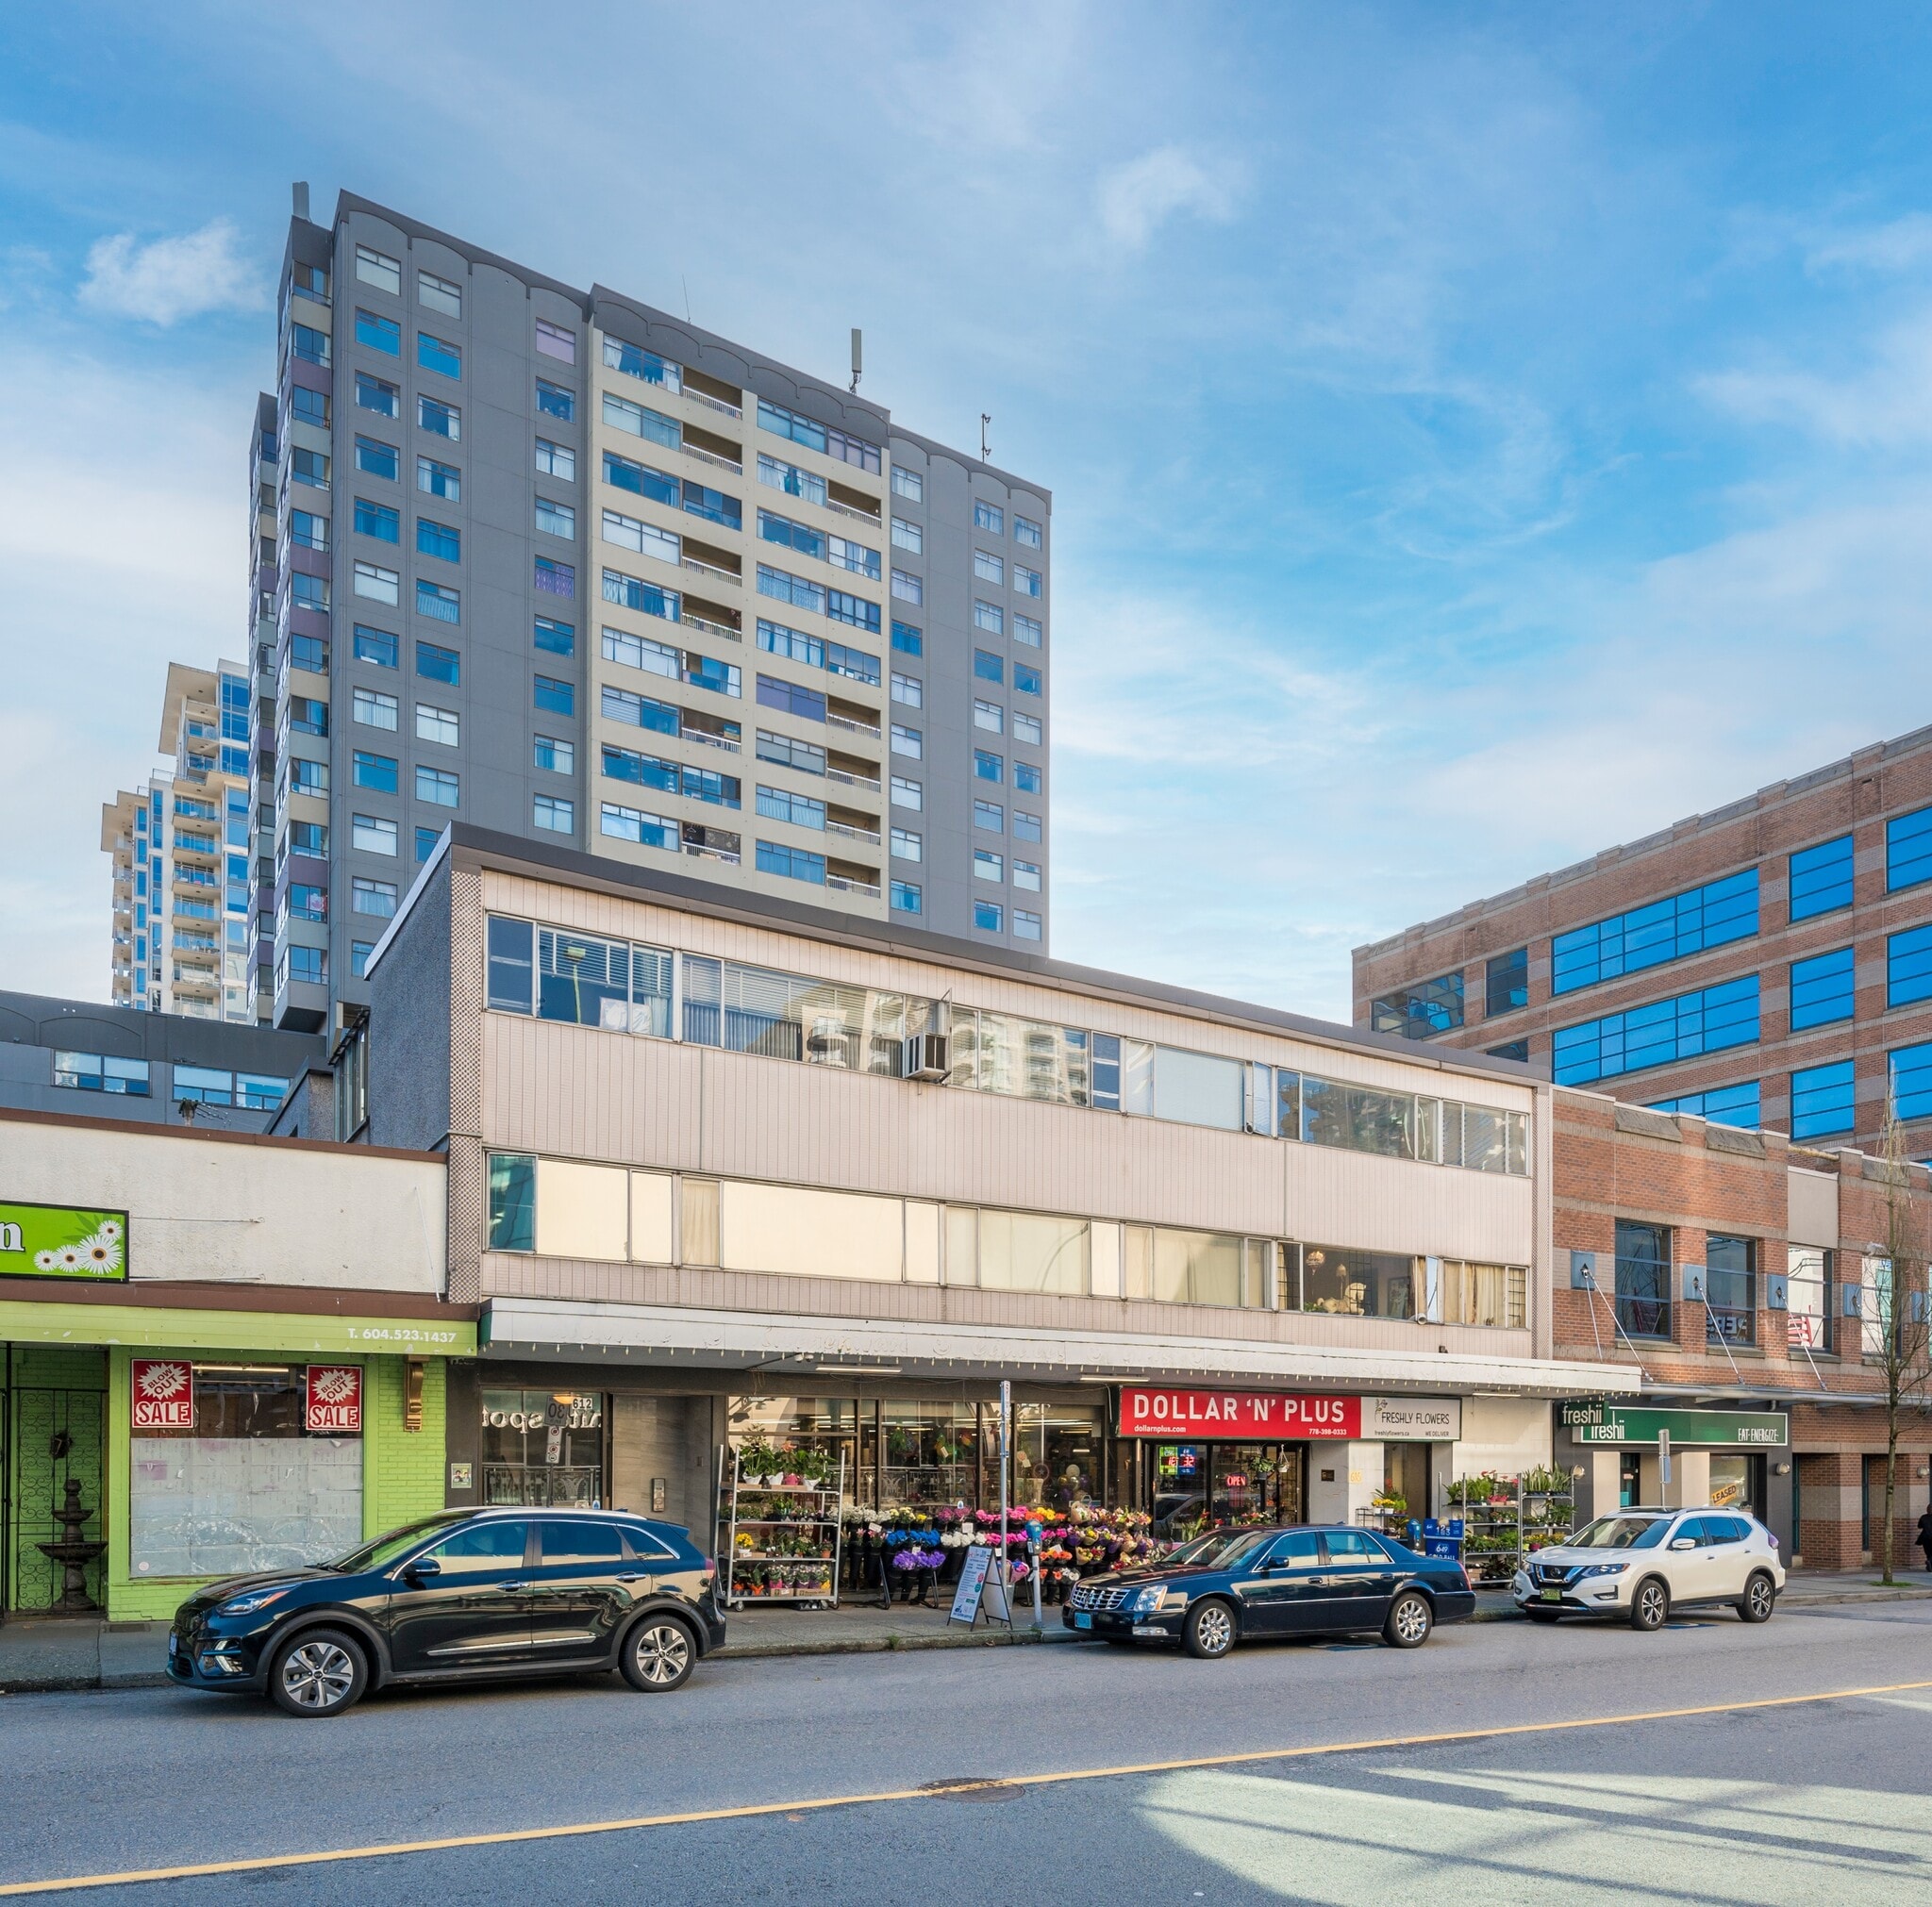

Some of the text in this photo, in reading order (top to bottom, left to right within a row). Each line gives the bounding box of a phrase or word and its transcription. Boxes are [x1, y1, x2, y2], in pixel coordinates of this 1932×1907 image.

[347, 1328, 457, 1343] T. 604.523.1437
[147, 1368, 173, 1389] BLOW
[154, 1374, 177, 1395] OUT
[320, 1373, 344, 1394] BLOW
[326, 1380, 348, 1400] OUT
[136, 1401, 190, 1424] SALE
[573, 1398, 591, 1409] 612
[1134, 1394, 1238, 1421] DOLLAR
[1284, 1399, 1344, 1423] PLUS
[308, 1404, 360, 1429] SALE
[1381, 1412, 1450, 1424] FRESHLY FLOWERS
[1562, 1404, 1602, 1424] freshii
[1134, 1424, 1186, 1434] dollarnplus.com
[1226, 1476, 1246, 1486] OPEN
[1712, 1484, 1737, 1503] LEASED
